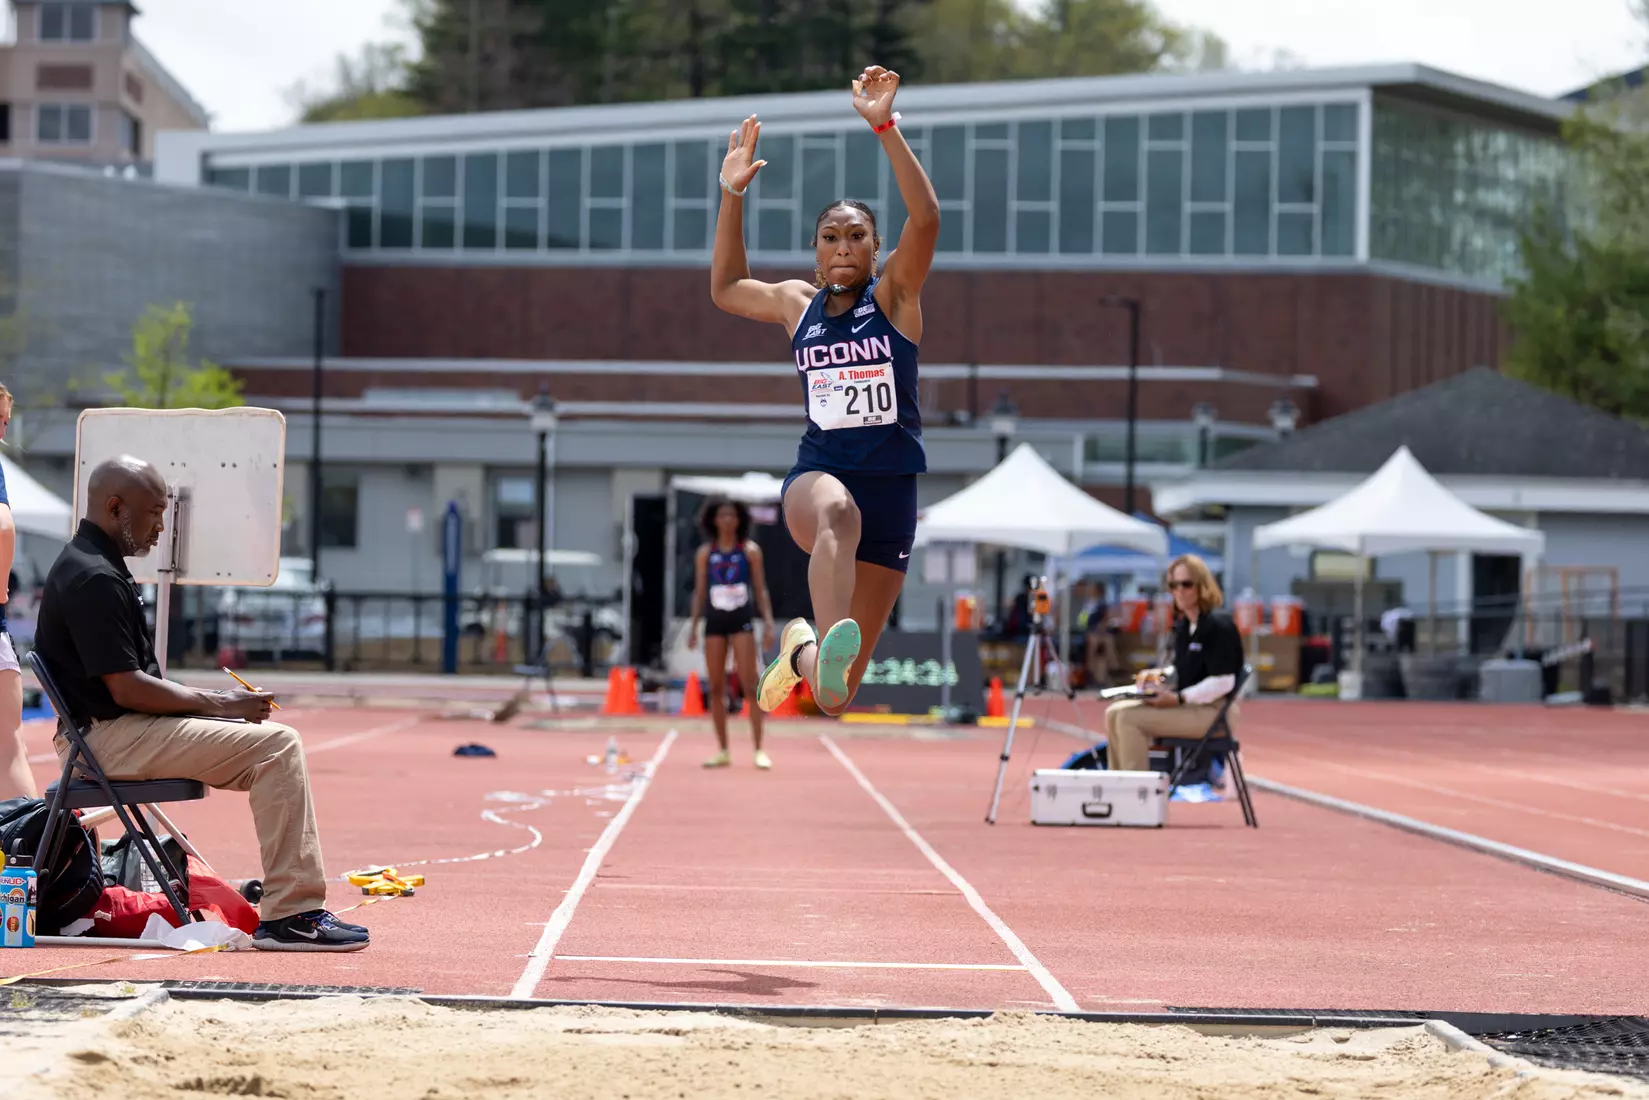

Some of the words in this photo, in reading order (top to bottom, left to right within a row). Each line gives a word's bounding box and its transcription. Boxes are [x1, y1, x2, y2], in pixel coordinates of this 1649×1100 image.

[795, 335, 892, 371] UCONN
[839, 371, 847, 380] A.
[848, 368, 885, 379] Thomas
[844, 382, 892, 415] 210
